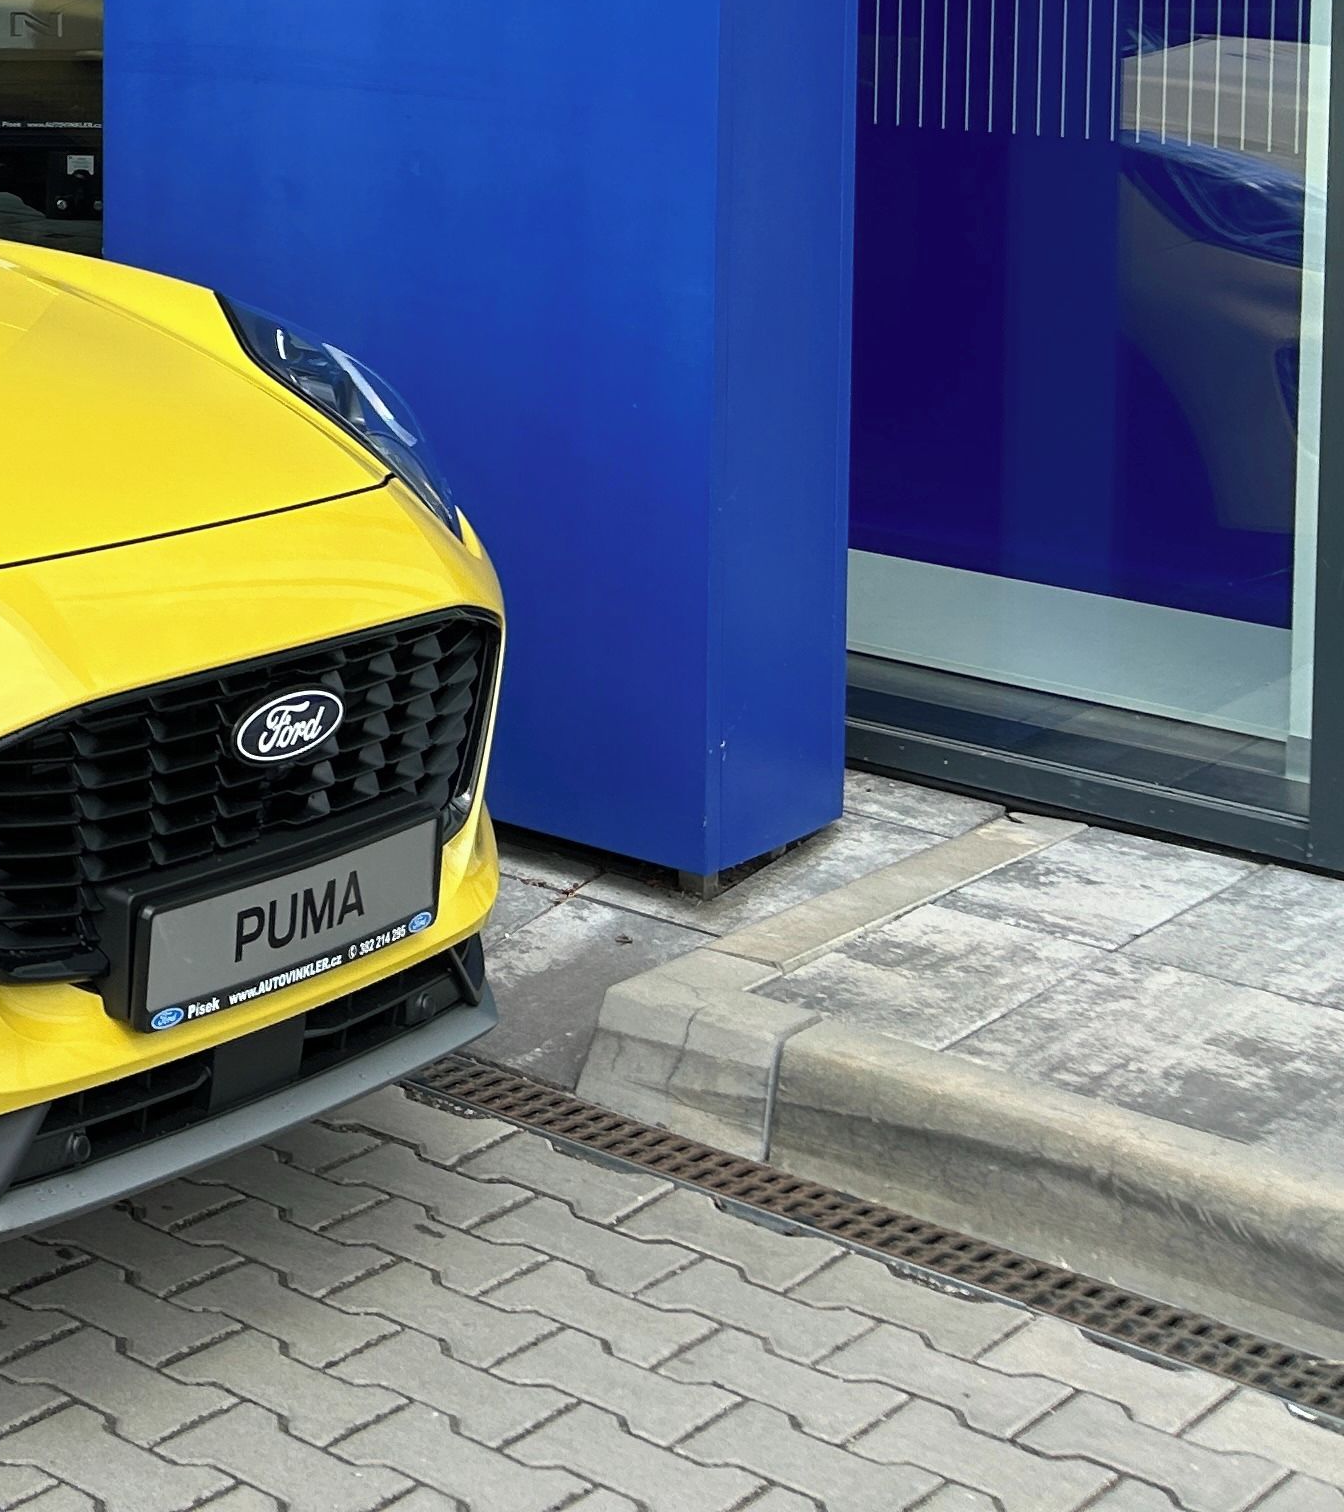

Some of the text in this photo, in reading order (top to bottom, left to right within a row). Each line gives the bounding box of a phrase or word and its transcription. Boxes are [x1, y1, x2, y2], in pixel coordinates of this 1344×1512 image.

[258, 700, 326, 754] Ford
[235, 870, 365, 963] PUMA
[228, 954, 343, 1006] www.AUTOVINKLER.cz
[375, 931, 391, 949] 214
